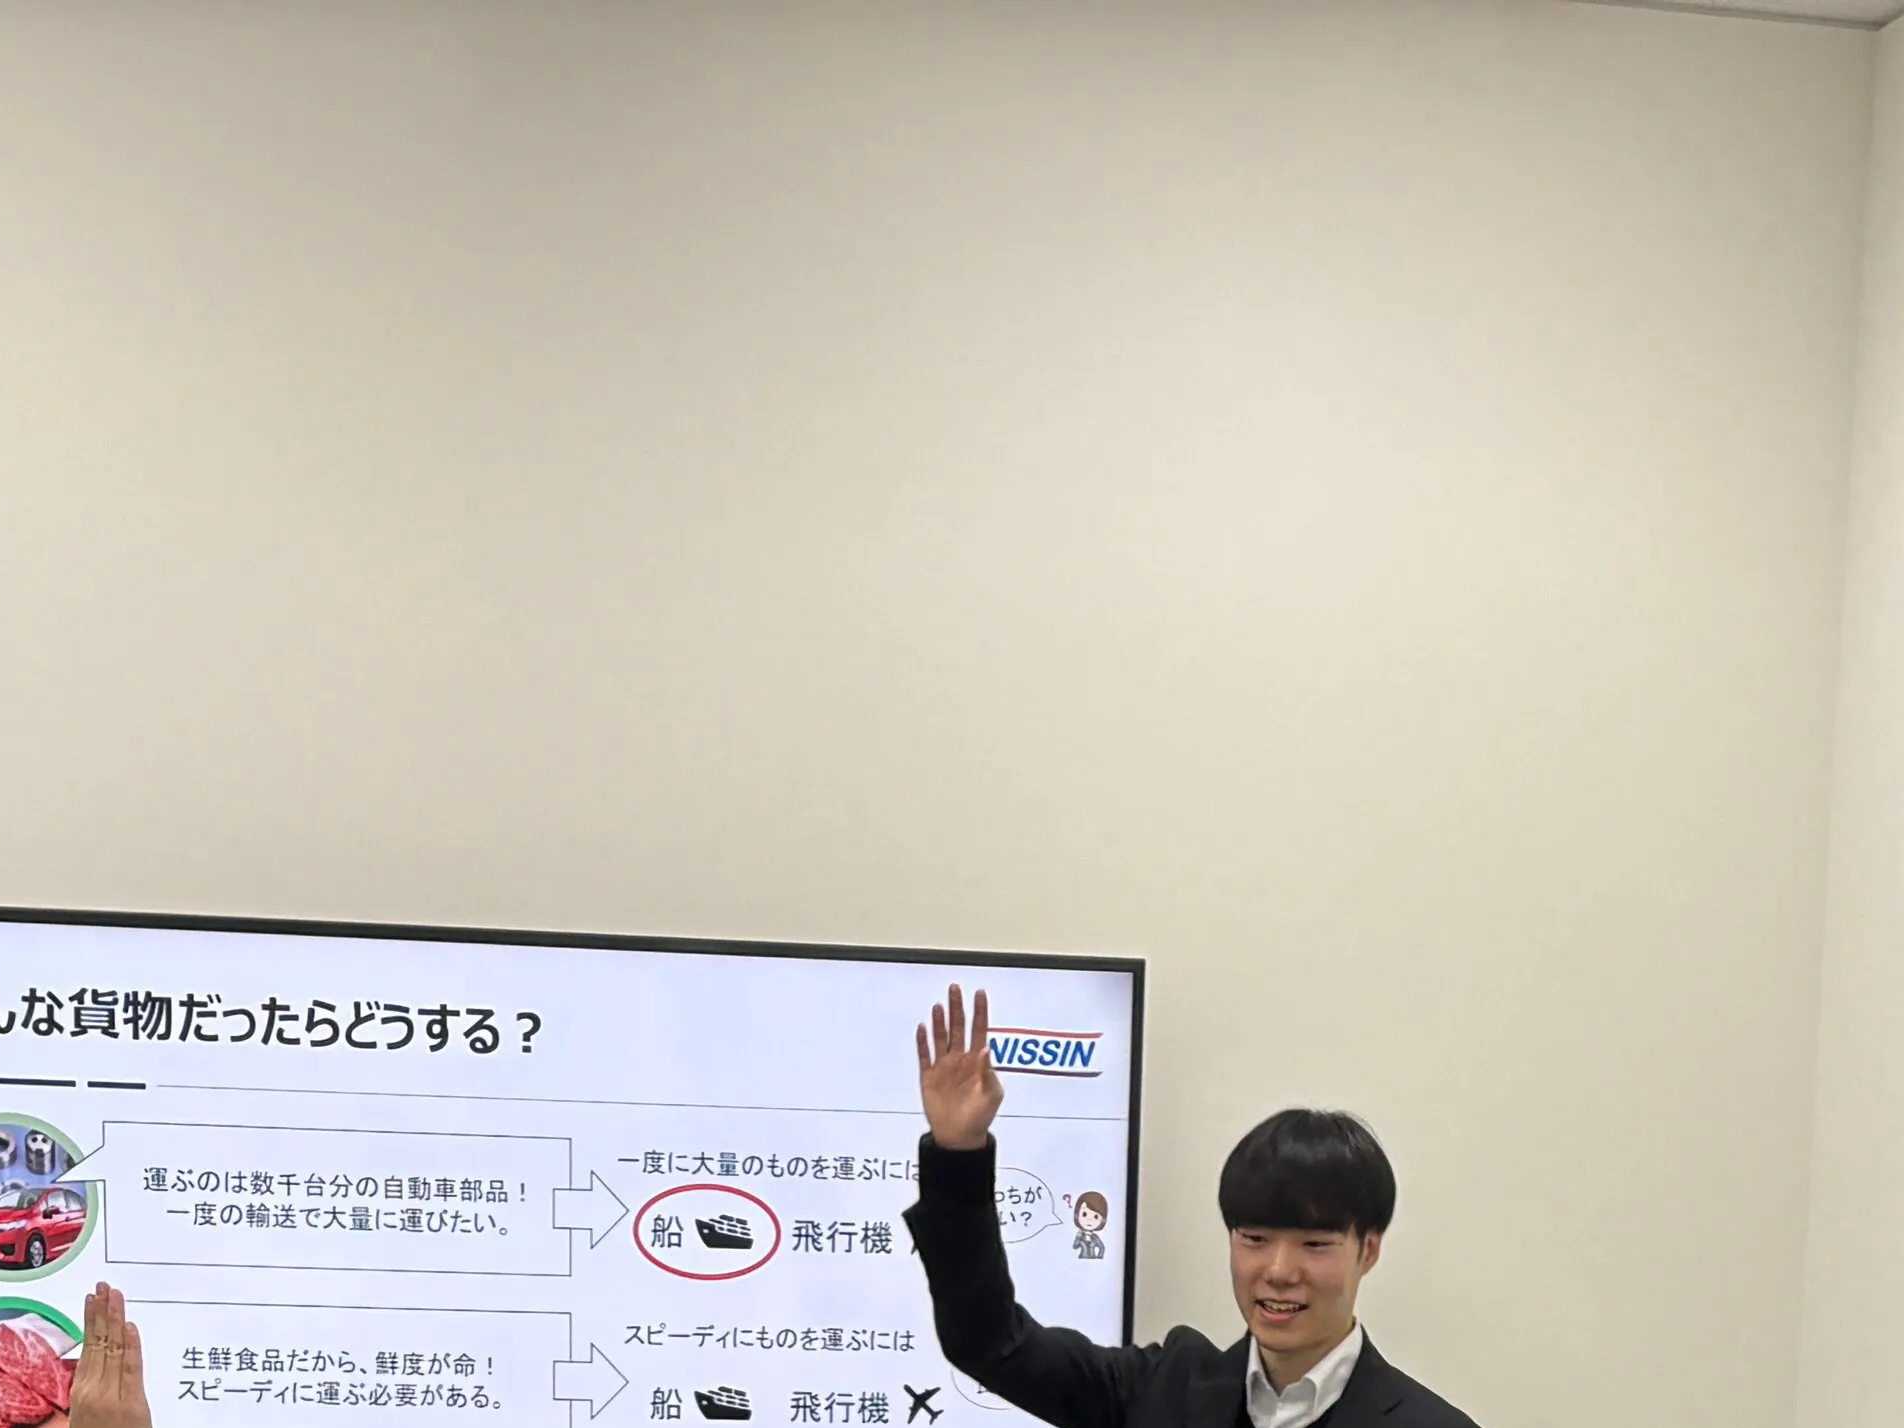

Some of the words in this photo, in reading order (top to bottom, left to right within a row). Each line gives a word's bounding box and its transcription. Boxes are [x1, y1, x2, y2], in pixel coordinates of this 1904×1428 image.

[989, 1037, 1096, 1068] NISSIN
[617, 1150, 920, 1183] 一度に大量のものを運ぶには
[142, 1167, 527, 1205] 運ぶのは数千台分の自動車部品！
[994, 1185, 1043, 1204] っちが
[166, 1202, 509, 1236] 一度の輸送で大量に運びたい。
[651, 1214, 684, 1249] 船
[999, 1211, 1032, 1227] い？
[792, 1219, 893, 1257] 飛行機
[623, 1324, 916, 1353] スピーディにものを運ぶには
[181, 1346, 495, 1377] 生鮮食品だから、鮮度が命！
[178, 1380, 502, 1410] スピーディに運ぶ必要がある。
[650, 1387, 683, 1421] 船
[789, 1390, 890, 1426] 飛行機
